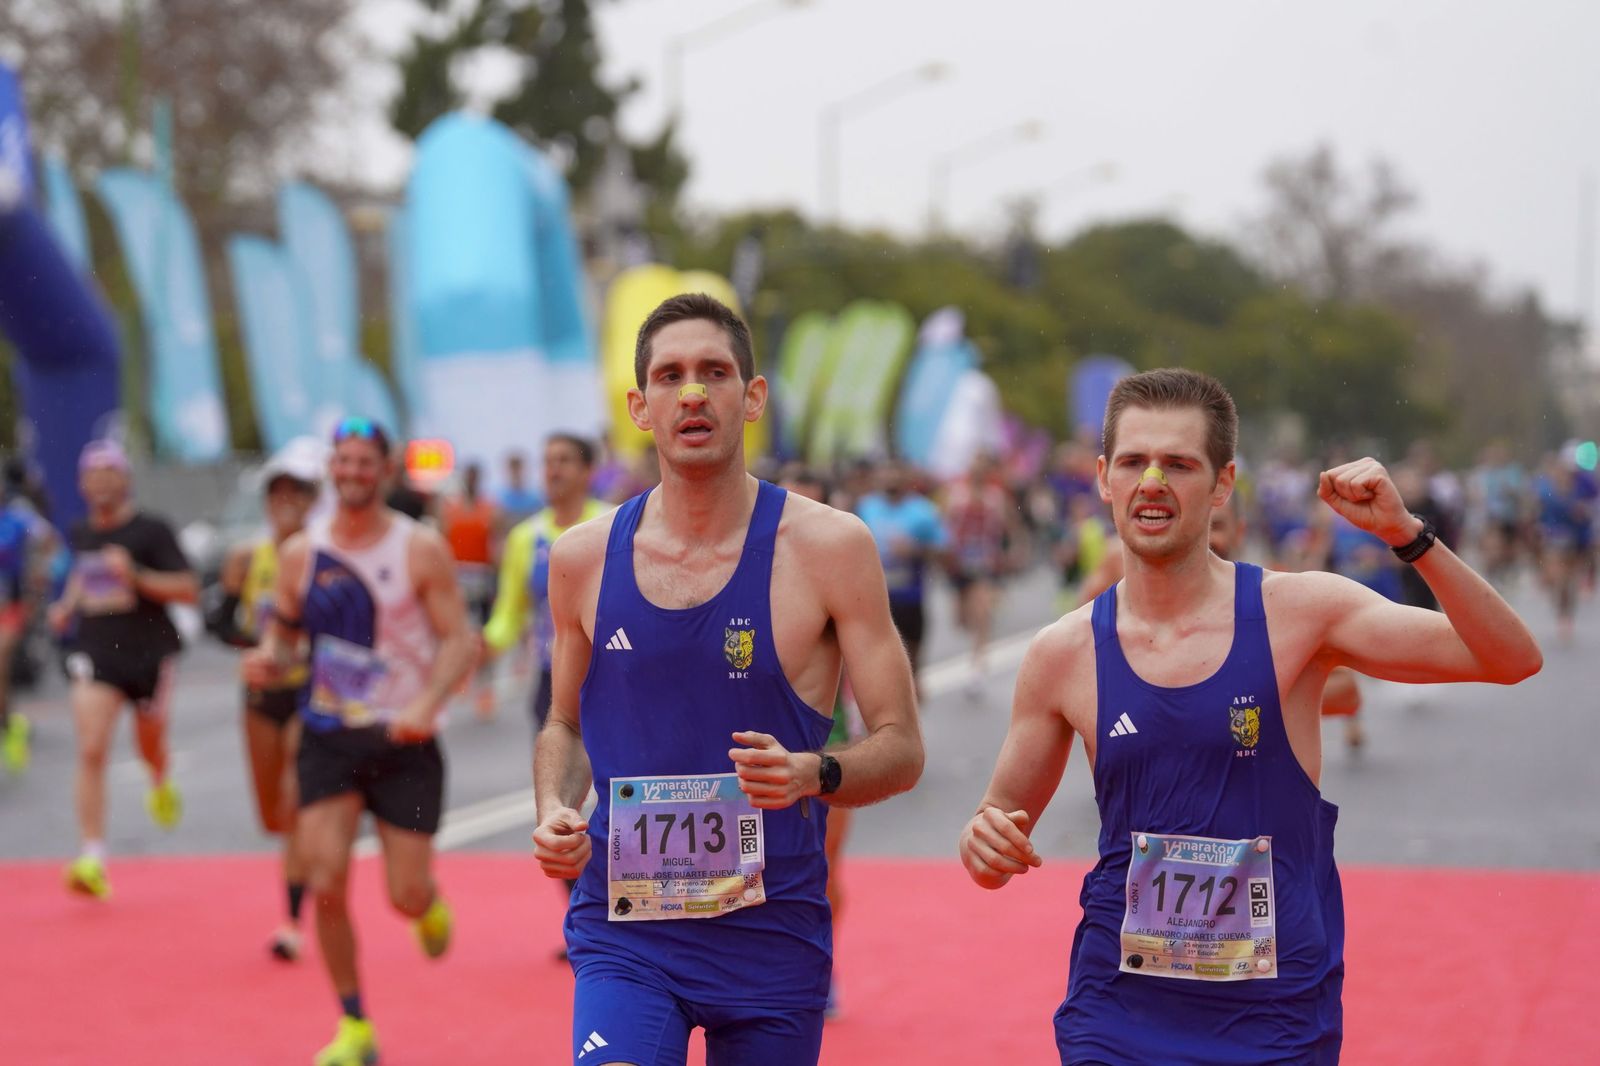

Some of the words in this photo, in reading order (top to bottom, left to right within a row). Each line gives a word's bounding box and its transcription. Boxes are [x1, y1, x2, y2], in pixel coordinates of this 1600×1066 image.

[729, 618, 751, 626] ADC
[728, 671, 749, 679] MDC
[1232, 695, 1255, 704] ADC
[1236, 749, 1256, 758] MDC
[658, 780, 709, 790] maratón
[670, 788, 708, 800] sevilla
[634, 812, 726, 855] 1713
[1180, 842, 1234, 854] maratón
[662, 858, 695, 867] MIGUEL
[1192, 852, 1232, 864] sevilla
[622, 872, 650, 880] MIGUEL
[674, 870, 707, 879] DUARTE
[709, 868, 742, 878] CUEVAS
[1152, 870, 1239, 918] 1712
[1166, 916, 1216, 928] ALEJANDRO
[1136, 928, 1182, 940] ALEJANDRO
[1183, 932, 1216, 941] DUARTE
[1218, 932, 1252, 940] CUEVAS
